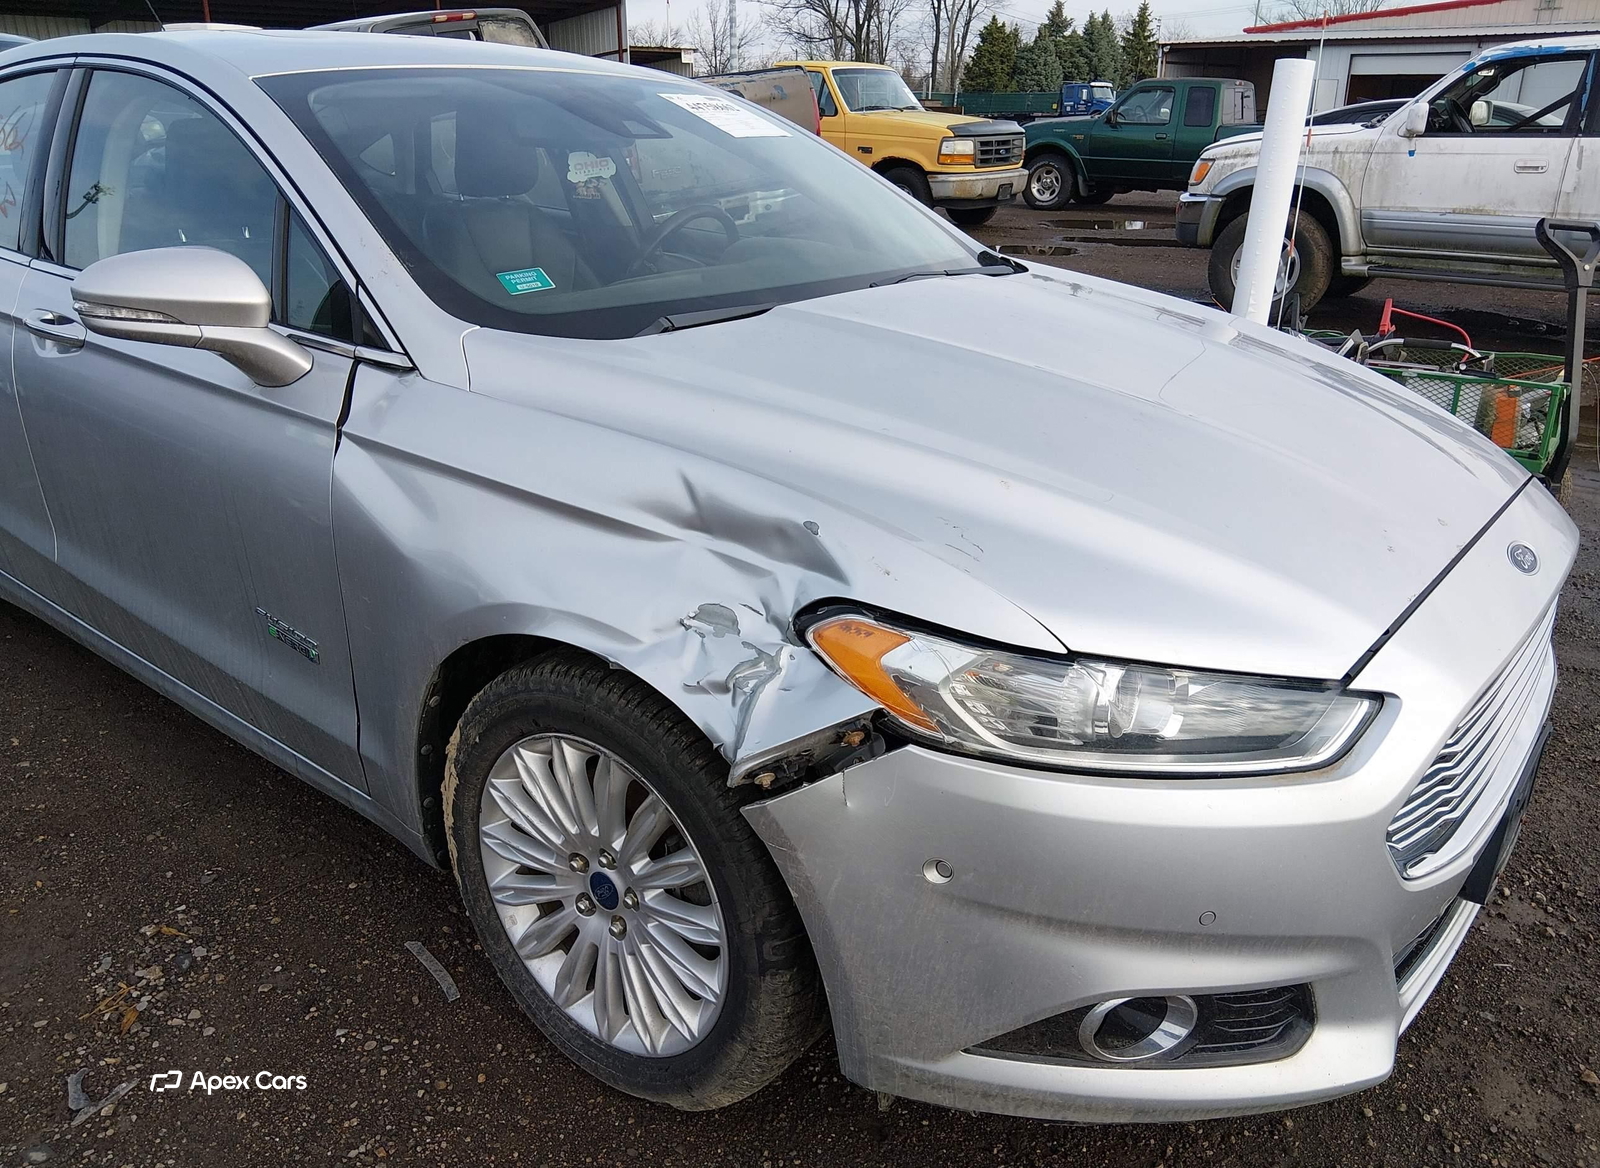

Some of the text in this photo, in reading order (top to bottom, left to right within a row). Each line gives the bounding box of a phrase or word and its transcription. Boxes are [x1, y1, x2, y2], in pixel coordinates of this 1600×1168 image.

[574, 160, 608, 170] OHIO
[505, 271, 537, 280] PARKING
[510, 276, 537, 284] PERMIT
